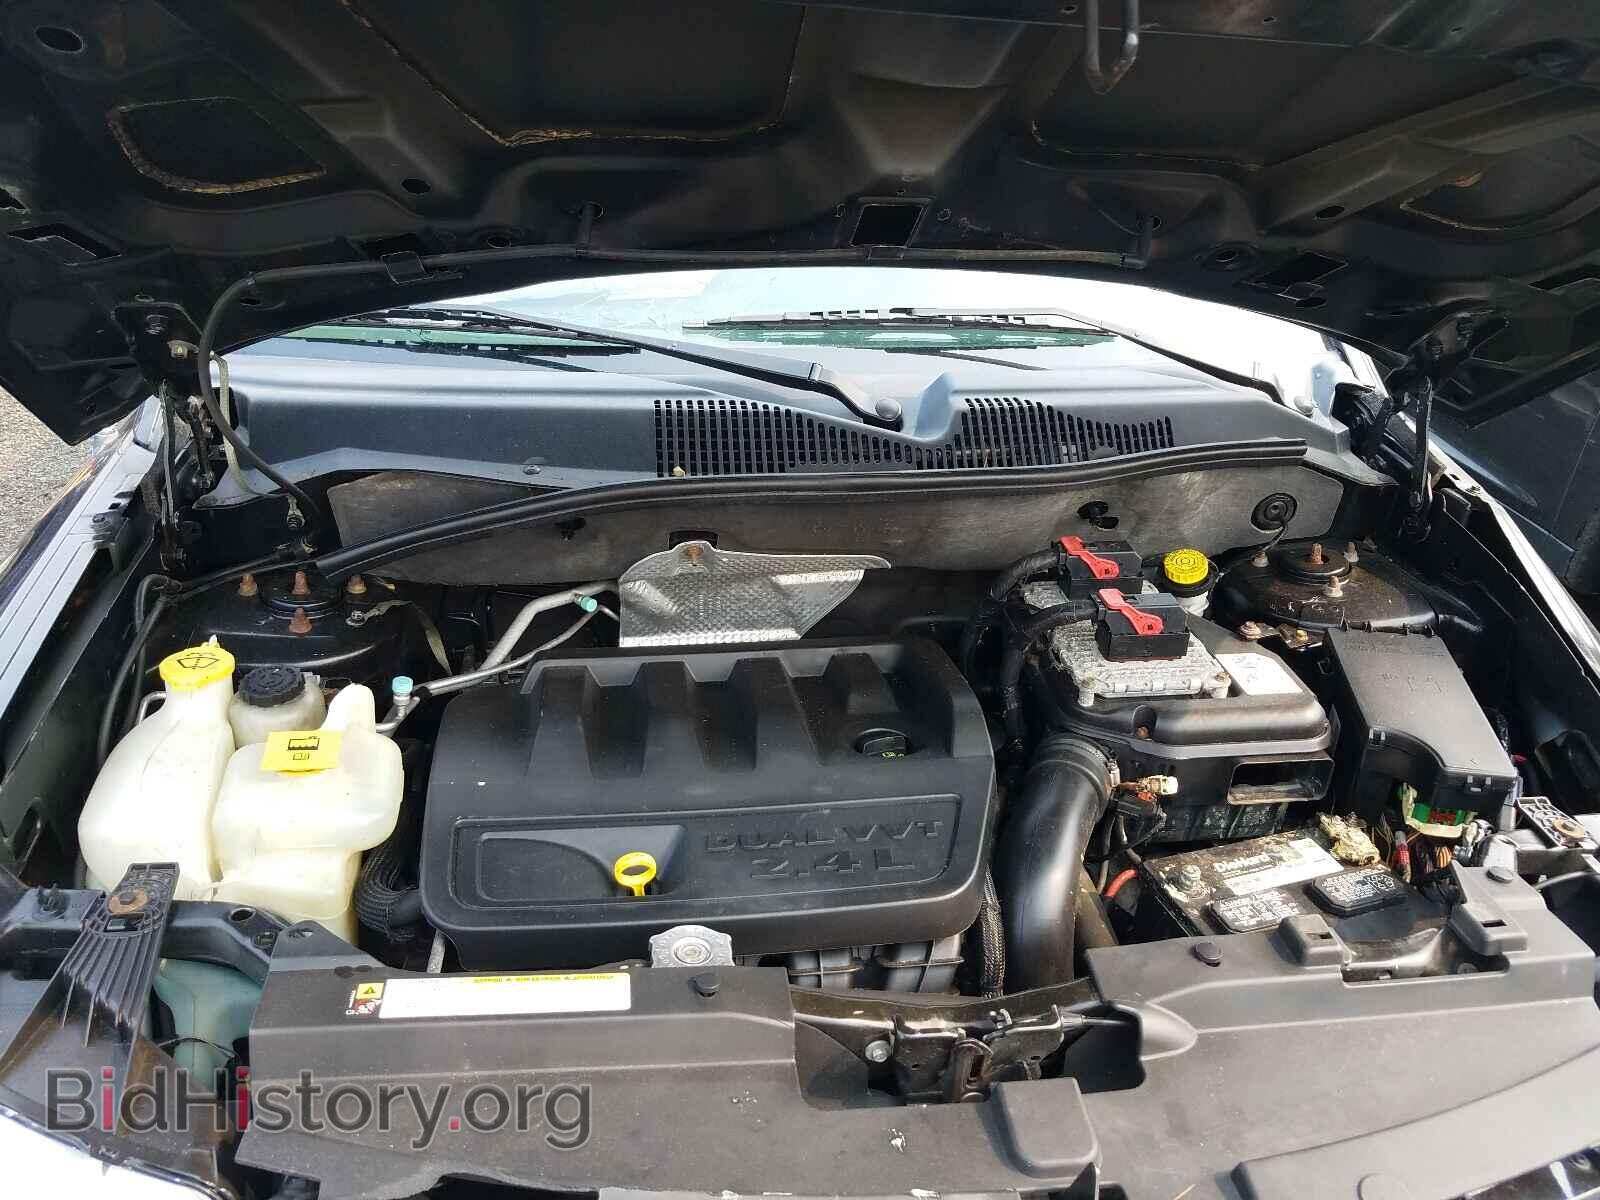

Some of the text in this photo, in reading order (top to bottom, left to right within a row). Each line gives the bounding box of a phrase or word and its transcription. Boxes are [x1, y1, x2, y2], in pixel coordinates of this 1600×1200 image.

[705, 820, 944, 853] DUAL VVT
[750, 848, 917, 880] 2.4L
